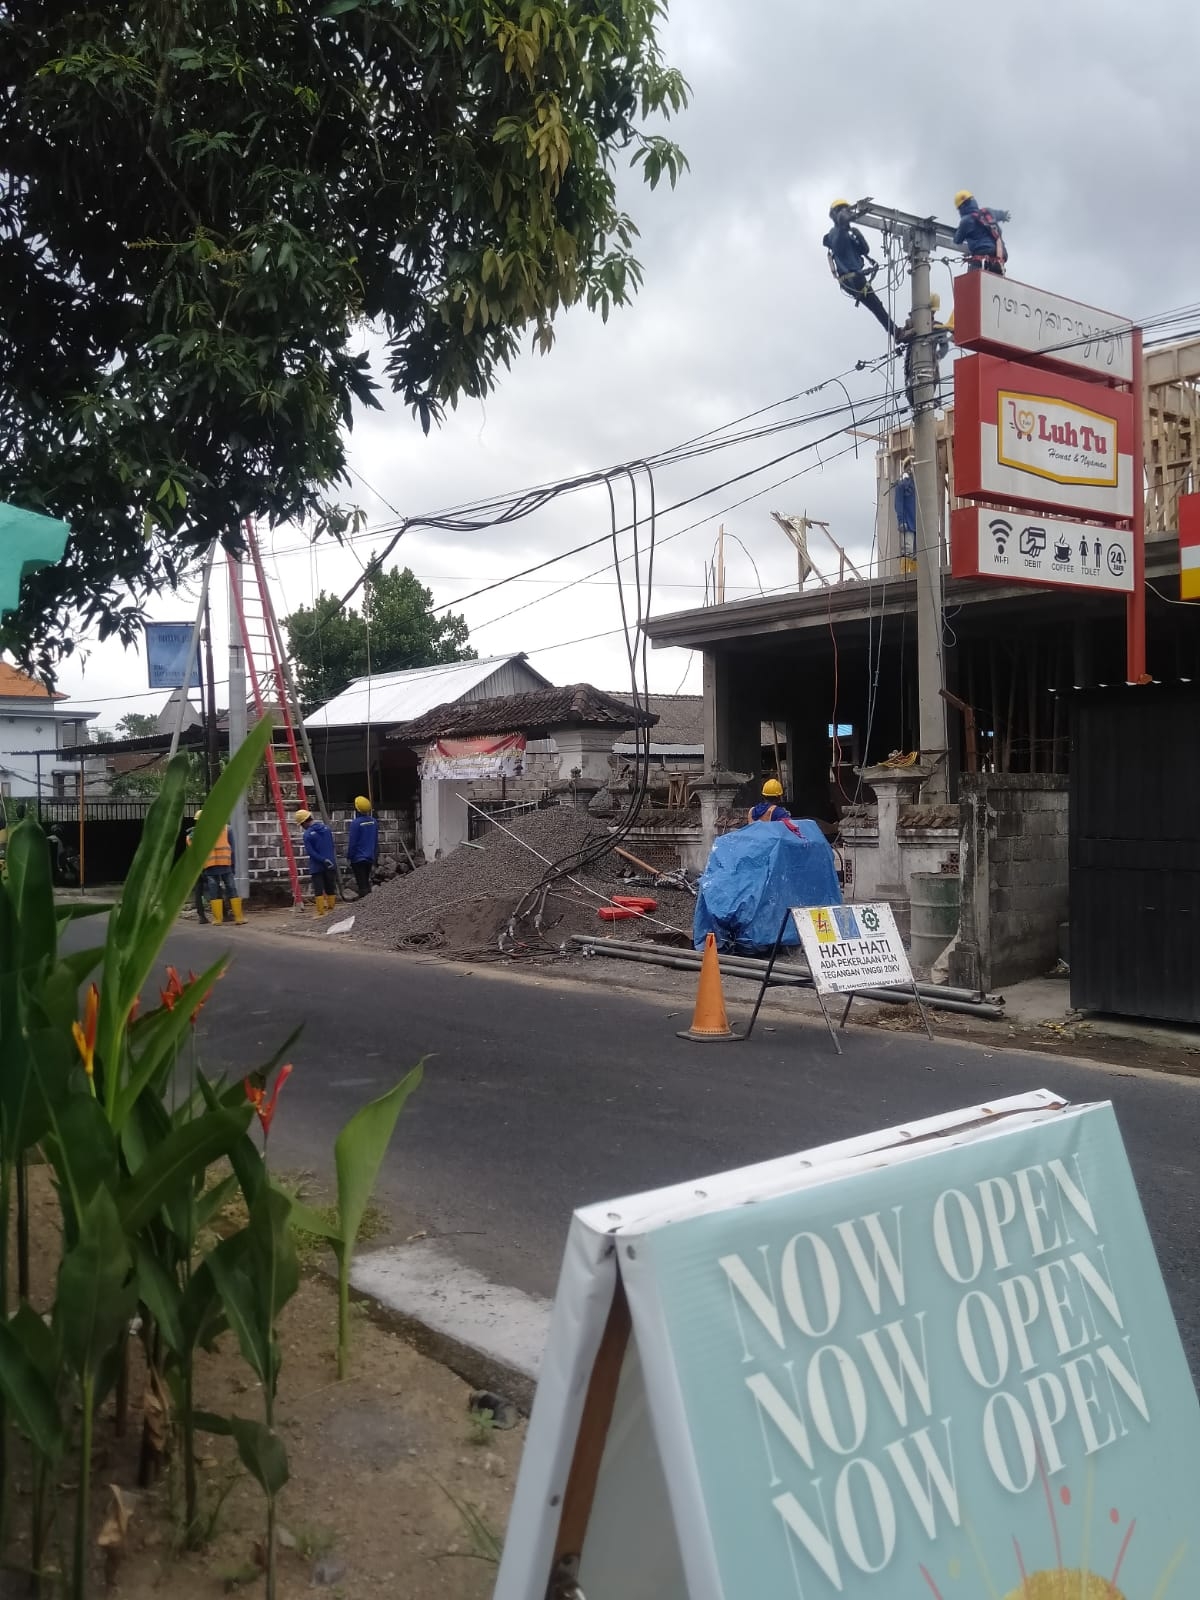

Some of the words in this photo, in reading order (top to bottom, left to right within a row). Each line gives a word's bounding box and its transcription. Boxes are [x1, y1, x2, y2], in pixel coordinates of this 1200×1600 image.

[993, 554, 1009, 565] WI-FI
[1024, 559, 1042, 569] DEBIT
[1110, 551, 1122, 564] 24
[1051, 562, 1075, 573] COFFEE
[1081, 566, 1100, 577] TOILET
[859, 940, 891, 955] HATI
[820, 959, 837, 969] ADA
[838, 957, 882, 968] PEKERJAAN
[882, 954, 897, 963] PLN
[822, 968, 861, 980] TEGANGAN
[861, 965, 883, 976] TINGGI
[718, 1206, 905, 1363] NOW
[933, 1153, 1099, 1284] OPEN
[745, 1311, 932, 1487] NOW
[957, 1244, 1124, 1388] OPEN
[772, 1416, 960, 1600] NOW
[983, 1336, 1151, 1494] OPEN
